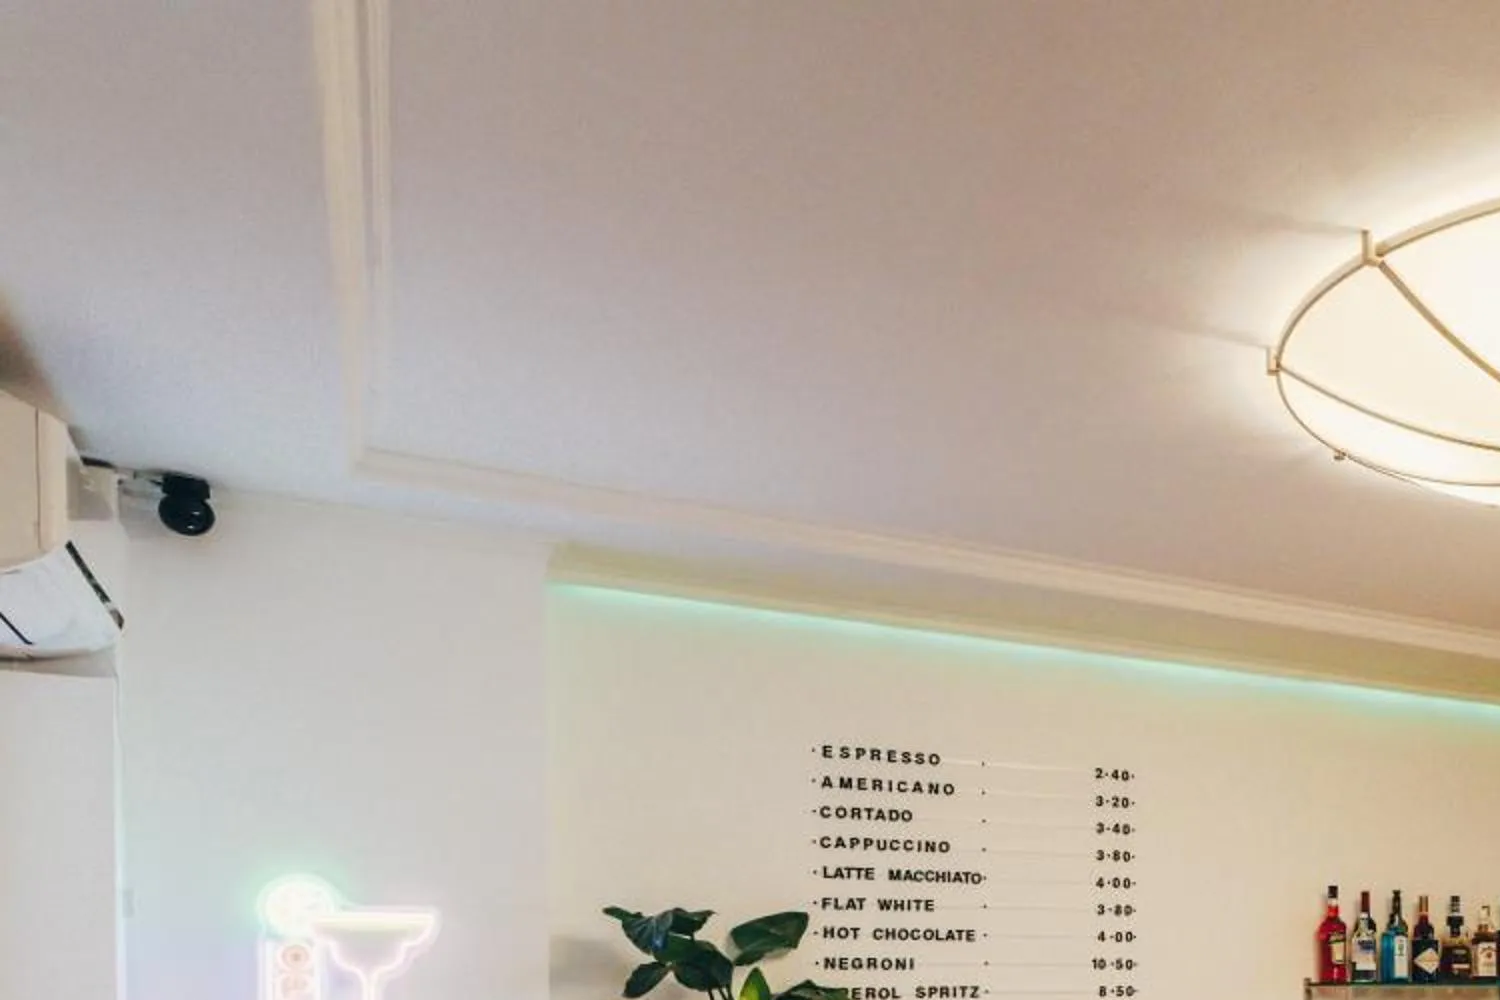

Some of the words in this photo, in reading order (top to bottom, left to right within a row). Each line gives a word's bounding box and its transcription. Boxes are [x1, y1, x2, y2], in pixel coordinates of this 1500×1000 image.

[821, 744, 941, 767] ESPRESSO
[820, 775, 955, 797] AMERICANO
[819, 805, 913, 823] CORTADO
[819, 835, 951, 854] CAPPUCCINO
[822, 865, 875, 880] LATTE
[888, 868, 983, 885] MACCHIATO
[820, 896, 866, 912] FLAT
[877, 898, 935, 912] WHITE
[822, 925, 861, 941] HOT
[872, 927, 976, 943] CHOCOLATE
[823, 956, 915, 972] NEGRONI
[848, 986, 901, 1000] EROL
[915, 985, 980, 1000] SPRITZ
